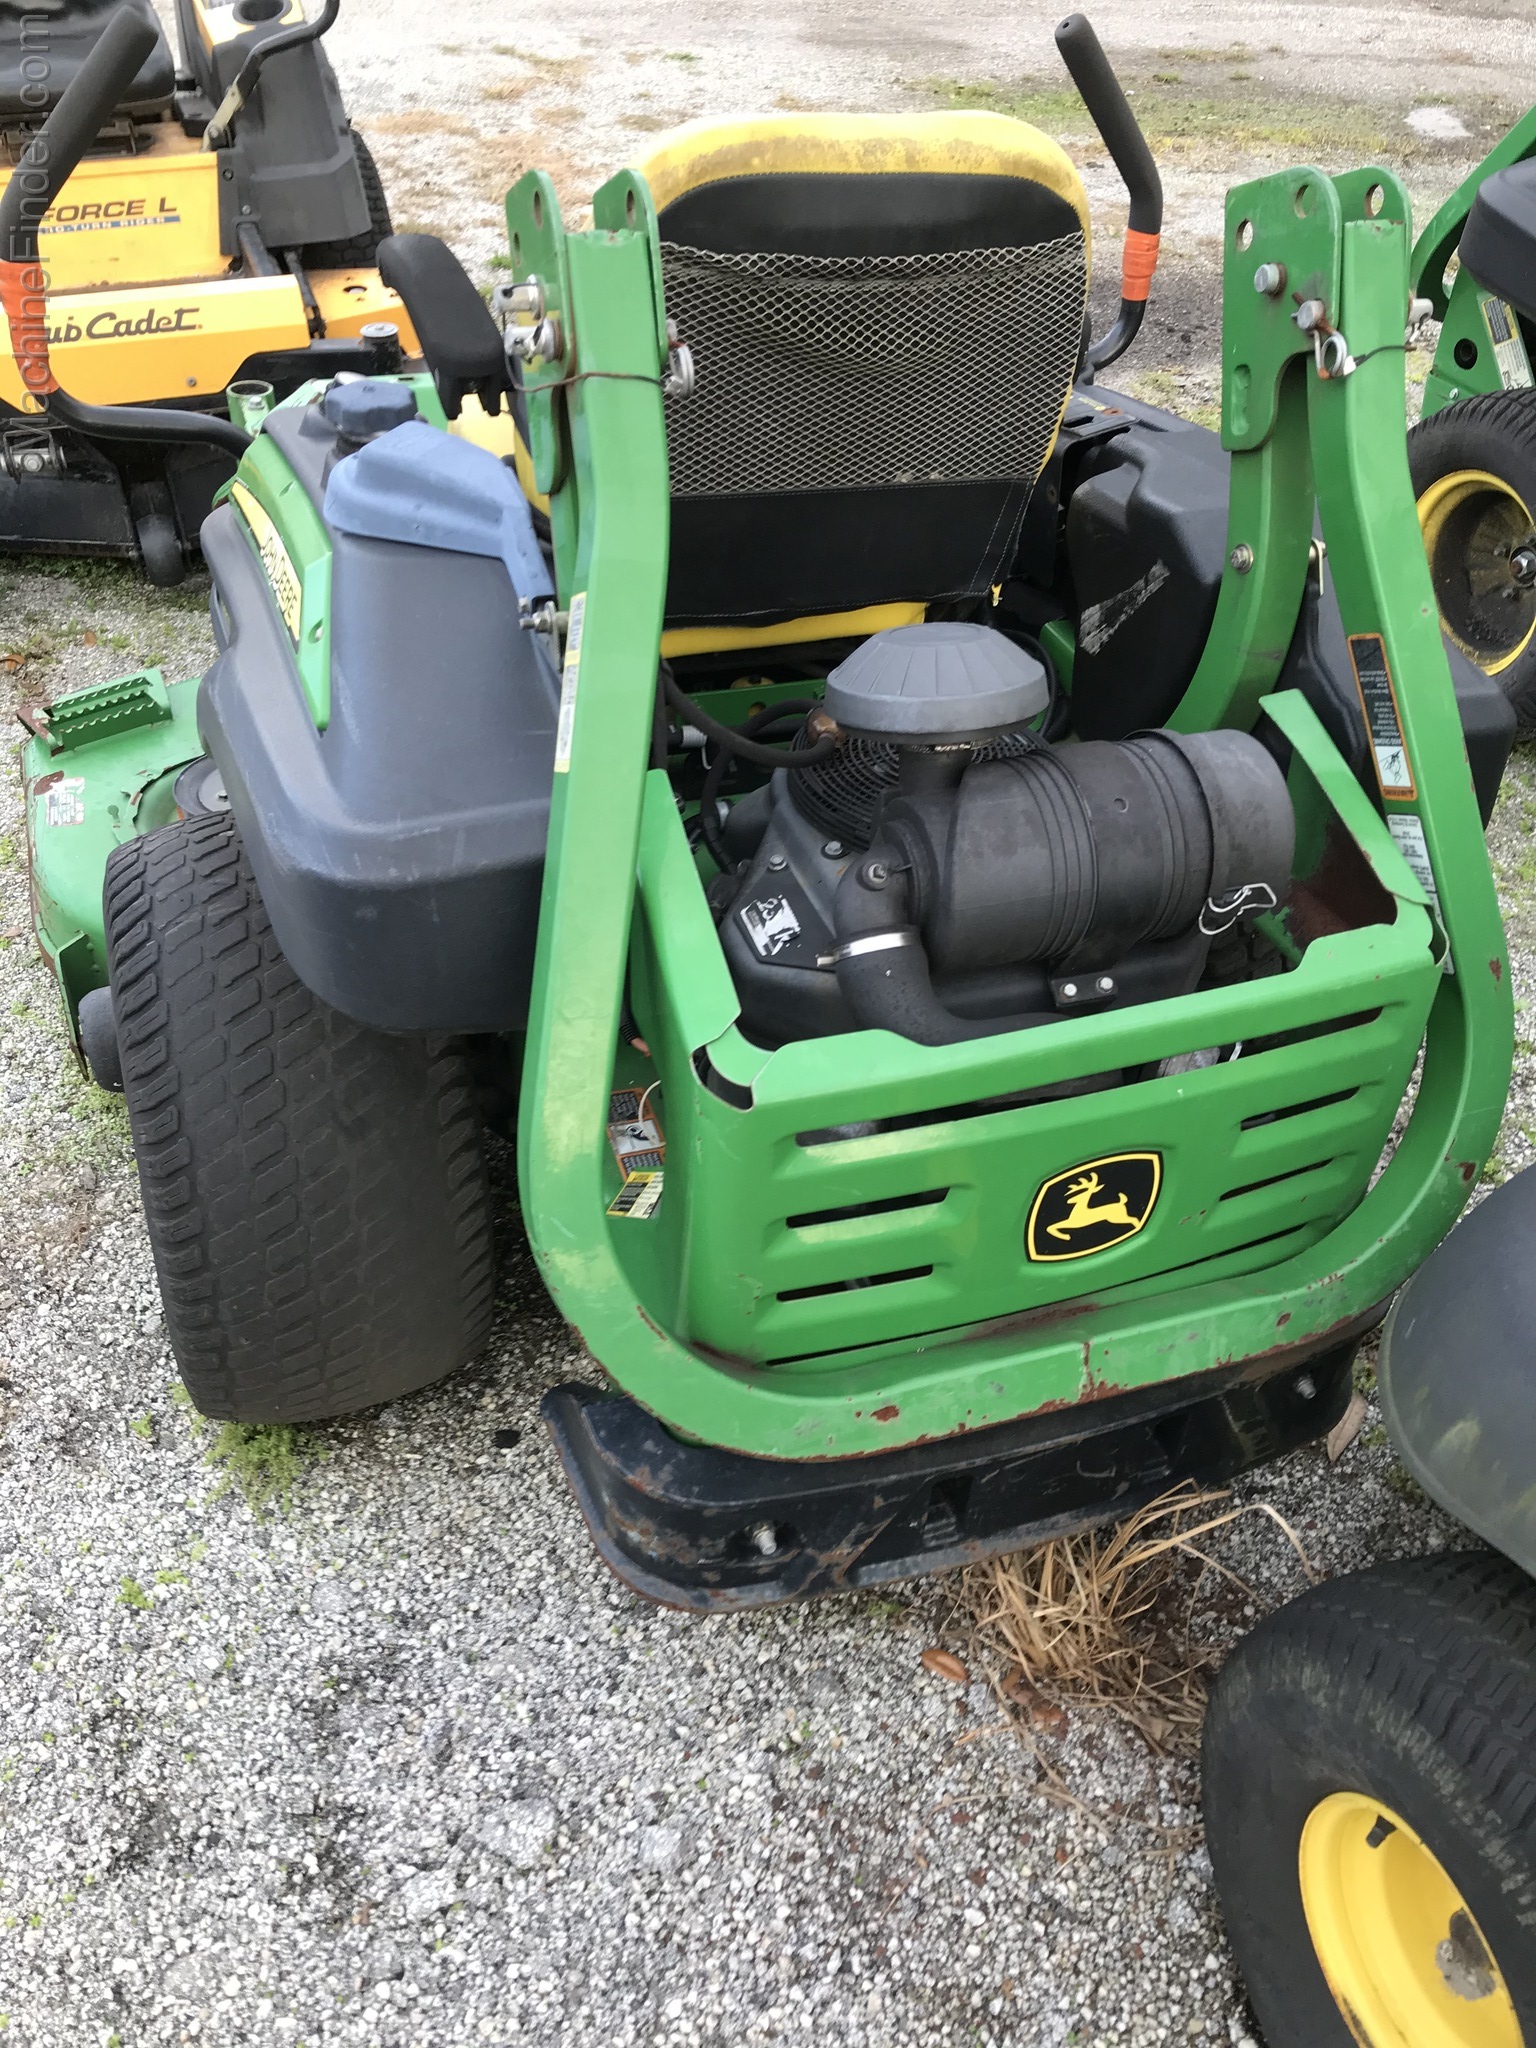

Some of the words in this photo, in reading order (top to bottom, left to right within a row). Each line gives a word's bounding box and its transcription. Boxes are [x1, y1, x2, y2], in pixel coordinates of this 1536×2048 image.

[159, 197, 177, 213] L
[46, 316, 82, 344] ub
[86, 308, 200, 339] Cadet
